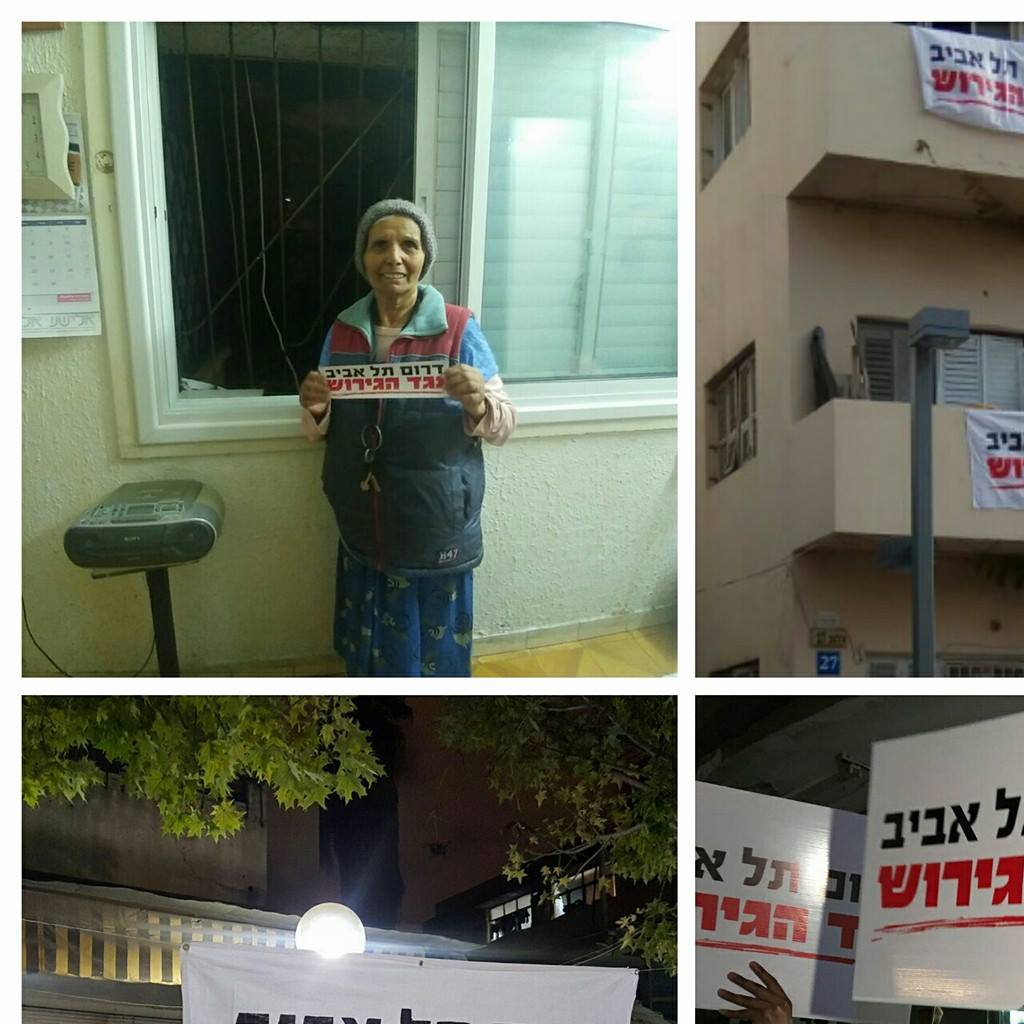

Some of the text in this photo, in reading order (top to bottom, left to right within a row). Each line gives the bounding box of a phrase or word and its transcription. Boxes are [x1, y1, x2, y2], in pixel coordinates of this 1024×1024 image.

[929, 44, 982, 70] אביב
[932, 70, 1024, 105] הגירוש
[326, 364, 444, 378] דרום תל אביב
[326, 378, 400, 391] הגירוש
[820, 656, 837, 670] 27
[881, 802, 980, 849] אביב
